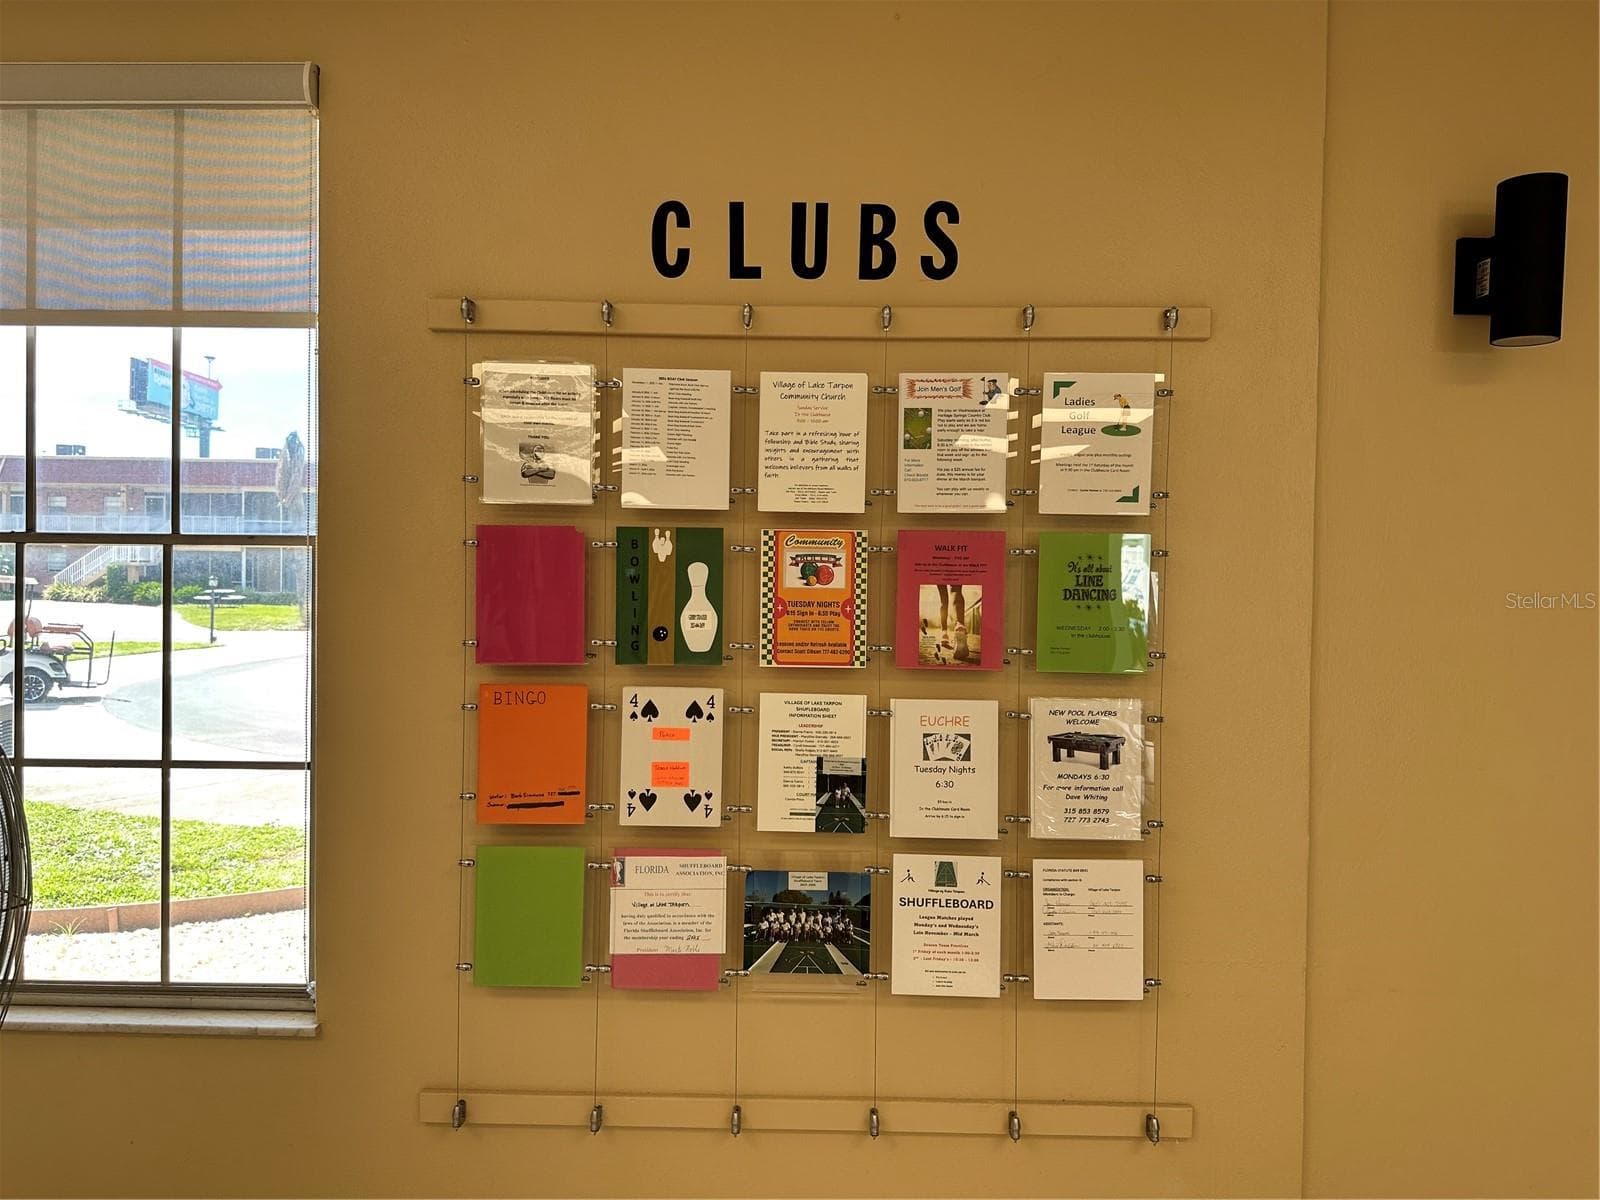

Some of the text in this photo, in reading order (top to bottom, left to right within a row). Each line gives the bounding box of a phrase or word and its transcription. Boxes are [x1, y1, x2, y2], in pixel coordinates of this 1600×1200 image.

[651, 200, 961, 281] CLUBS
[773, 381, 795, 390] Village
[828, 382, 853, 390] Tarpon
[780, 393, 818, 401] Community
[1064, 398, 1095, 406] Ladies
[1069, 411, 1090, 420] Golf
[1061, 426, 1096, 436] League
[785, 535, 844, 548] Community
[1067, 561, 1112, 573] It's all about
[1075, 575, 1104, 587] LINE
[630, 539, 640, 651] BOWLING
[1063, 589, 1117, 600] DANCING
[493, 690, 546, 705] BINGO
[630, 694, 638, 707] 4
[707, 695, 715, 708] 4
[920, 715, 970, 727] EUCHRE
[914, 765, 976, 775] Tuesday Nights
[936, 780, 954, 788] 6:30
[627, 803, 636, 817] 4
[704, 804, 713, 819] 4
[635, 866, 669, 874] FLORIDA
[899, 897, 994, 910] SHUFFLEBOARD
